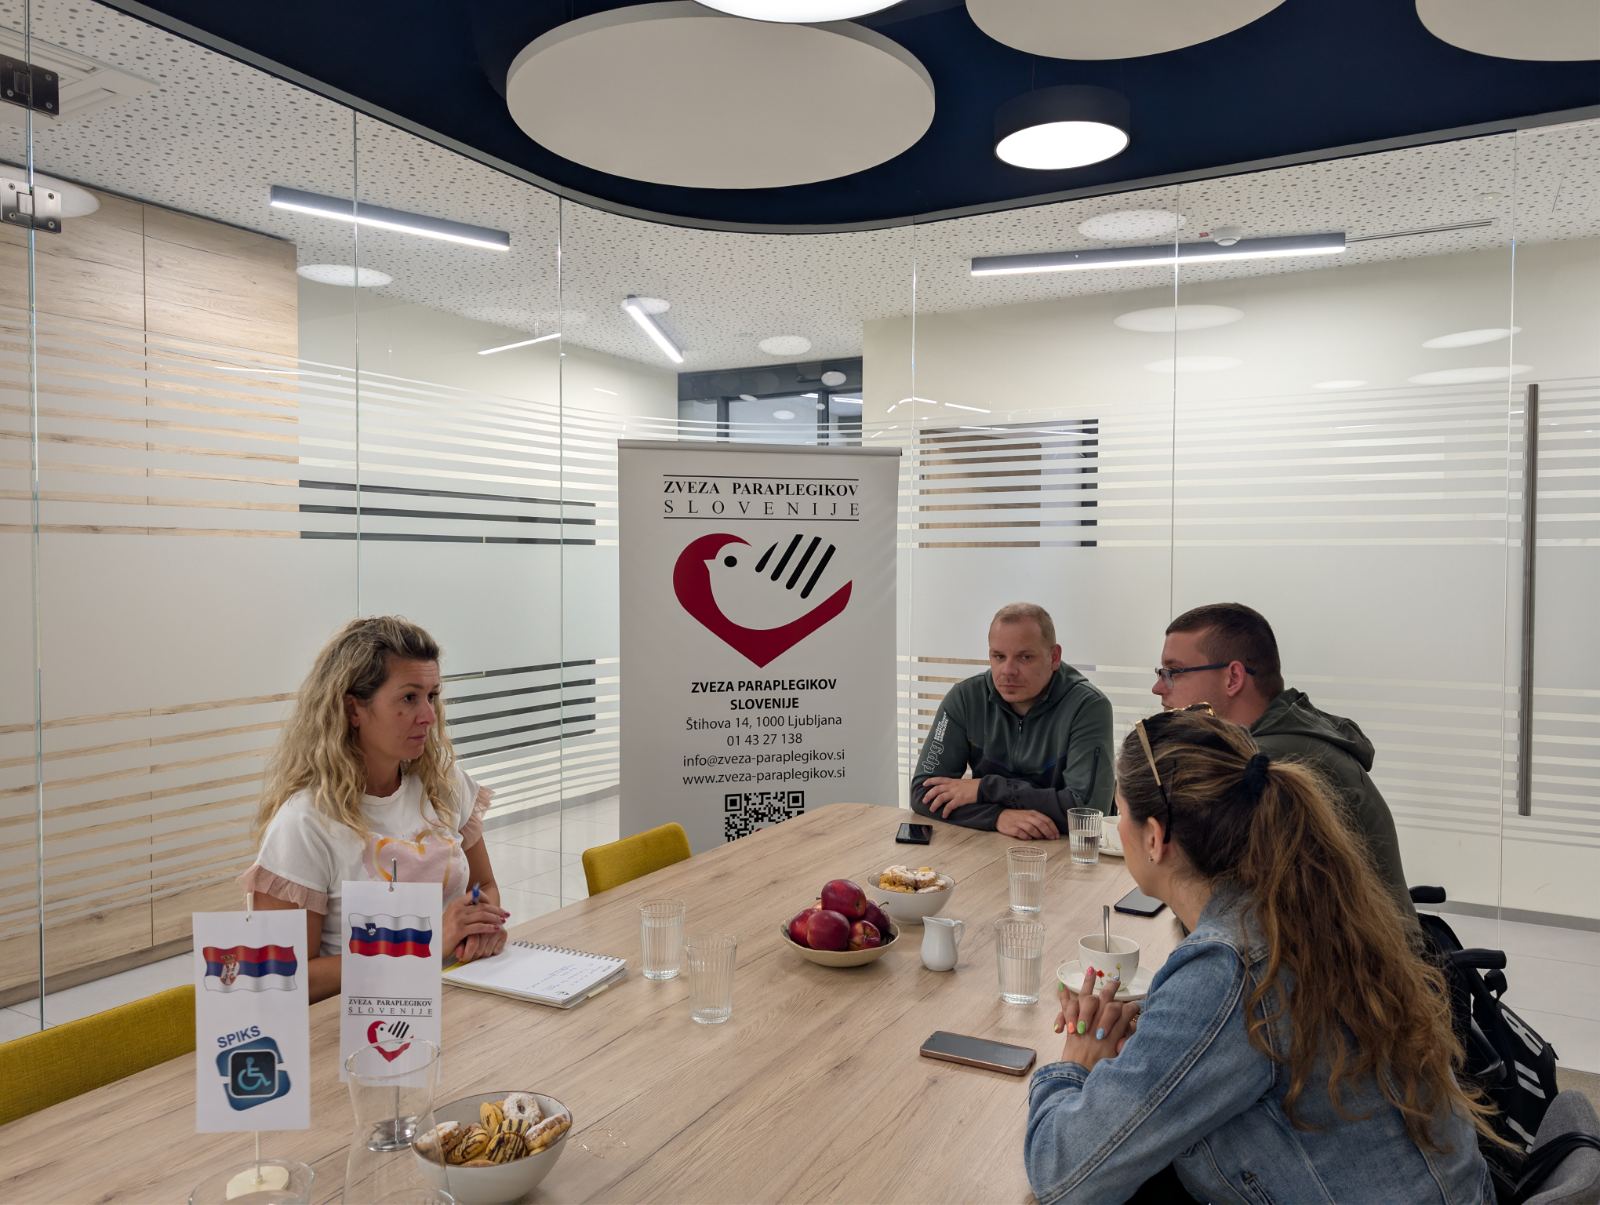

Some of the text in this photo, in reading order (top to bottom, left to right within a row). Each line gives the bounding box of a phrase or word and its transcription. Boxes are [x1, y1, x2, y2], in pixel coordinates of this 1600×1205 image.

[663, 480, 860, 497] ZVEZA PARAPLEGIKOV
[663, 499, 860, 517] SLOVENIJE
[691, 678, 837, 694] ZVEZA PARAPLEGIKOV
[730, 697, 800, 711] SLOVENIJE
[686, 714, 842, 731] Štihova 14, 1000 Ljubljana
[726, 732, 803, 747] 01 43 27 138
[683, 749, 845, 767] info@zveza-paraplegikov.si
[682, 766, 846, 785] www.zveza-paraplegikov.si
[348, 1006, 433, 1015] SLOVENIJE
[216, 1025, 261, 1048] SPIKS
